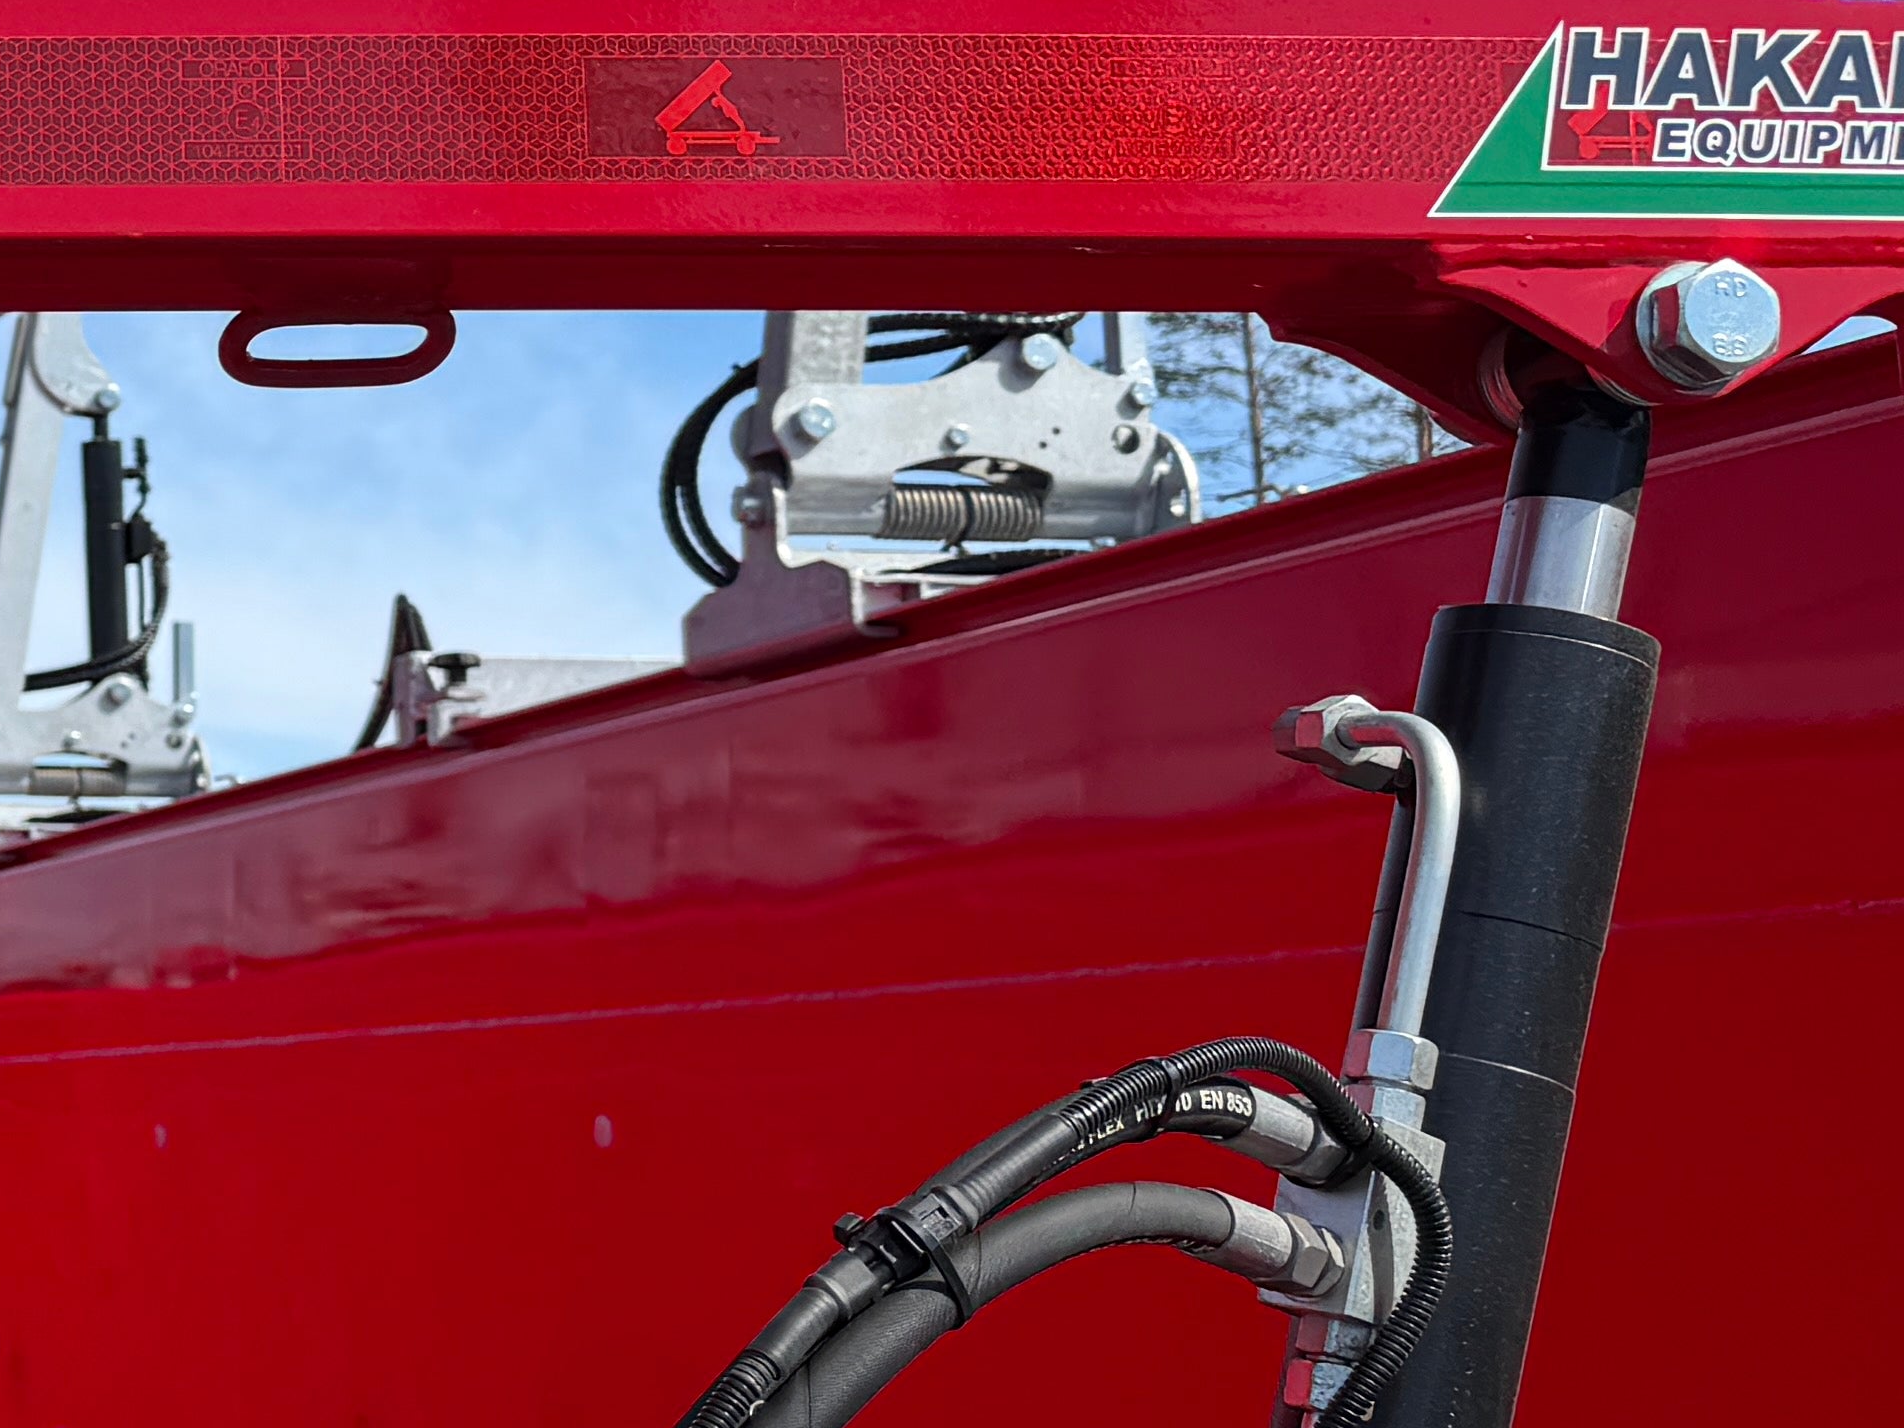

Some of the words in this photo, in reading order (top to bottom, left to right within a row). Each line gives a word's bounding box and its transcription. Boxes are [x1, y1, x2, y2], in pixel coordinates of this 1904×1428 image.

[1562, 28, 1904, 112] HAKA
[1199, 1089, 1223, 1110] EN
[1226, 1091, 1252, 1117] 853
